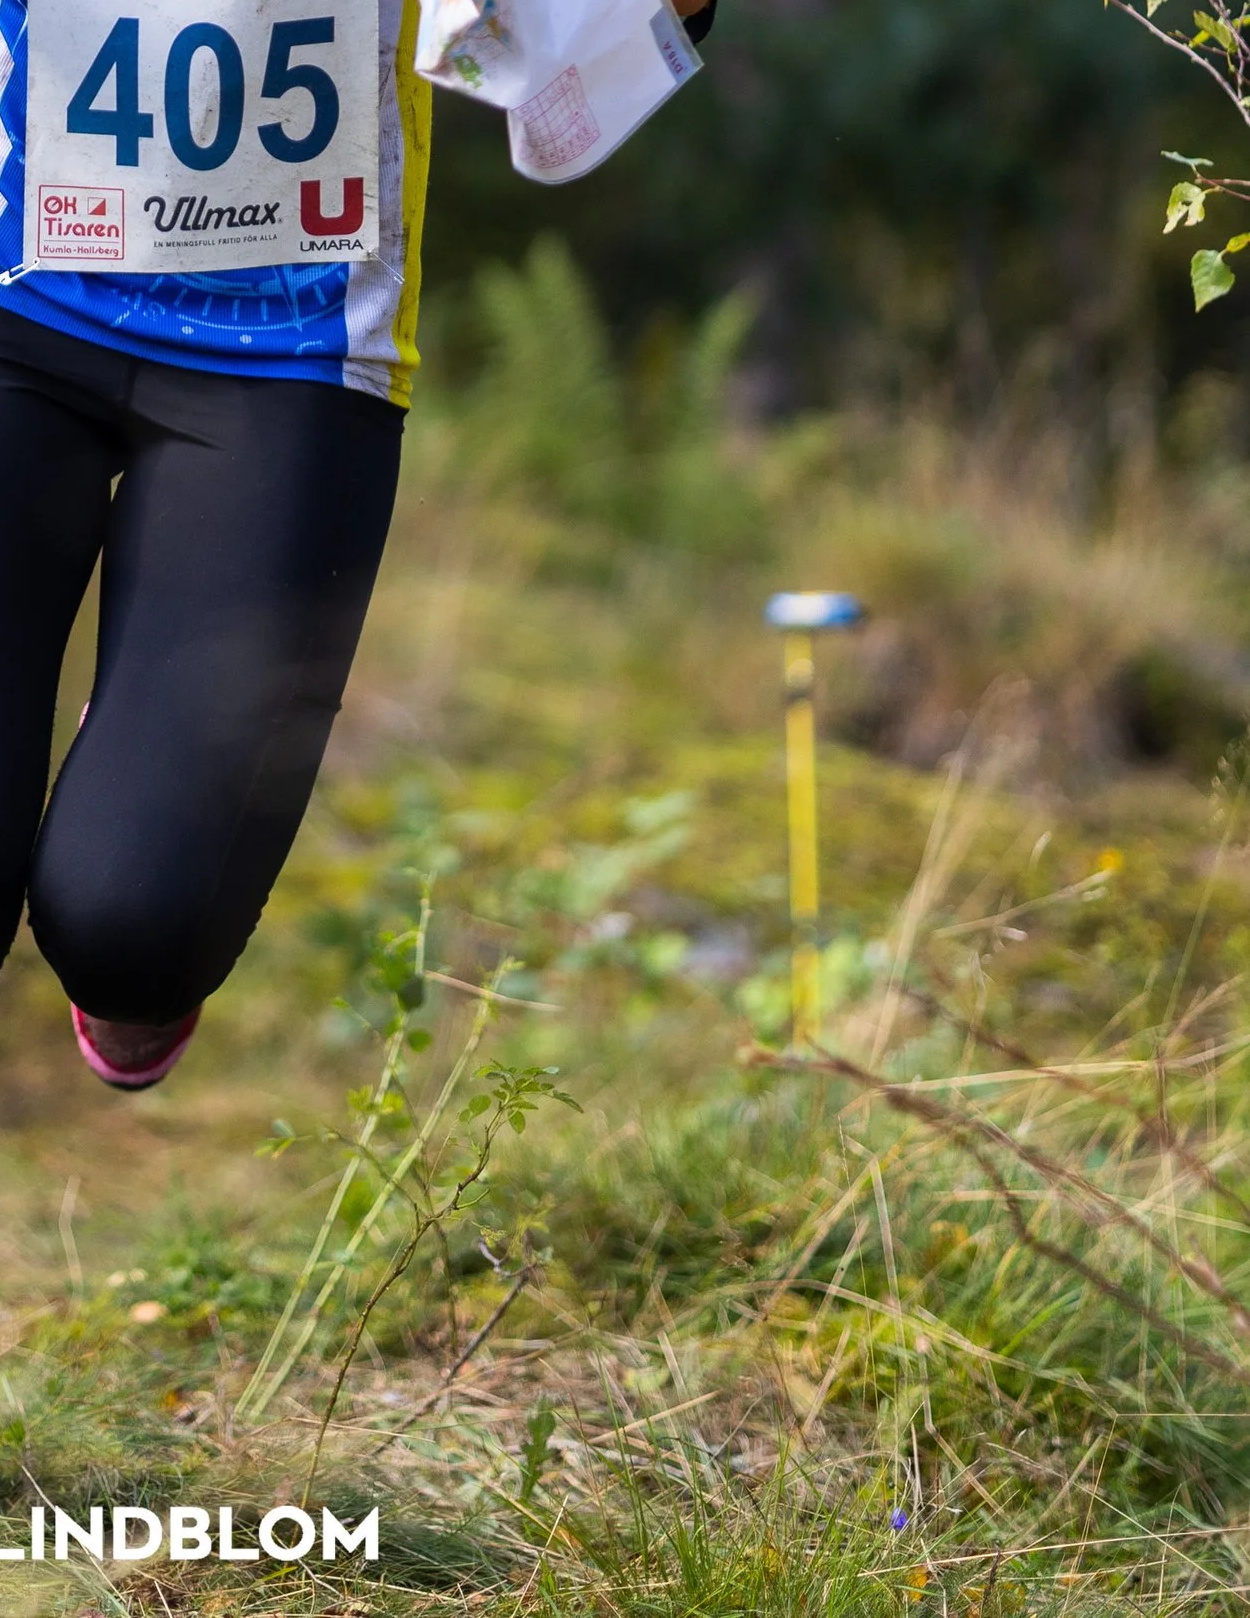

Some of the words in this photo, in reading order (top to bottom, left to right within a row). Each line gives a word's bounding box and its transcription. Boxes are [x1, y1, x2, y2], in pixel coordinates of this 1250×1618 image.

[66, 16, 340, 171] 405
[143, 195, 280, 232] Ullmax
[44, 217, 120, 238] Tisaren
[165, 240, 216, 248] MENINGSFULL
[218, 237, 241, 245] FRITID
[243, 235, 257, 243] FÖR
[260, 234, 278, 242] ALLA
[300, 239, 364, 252] UMARA
